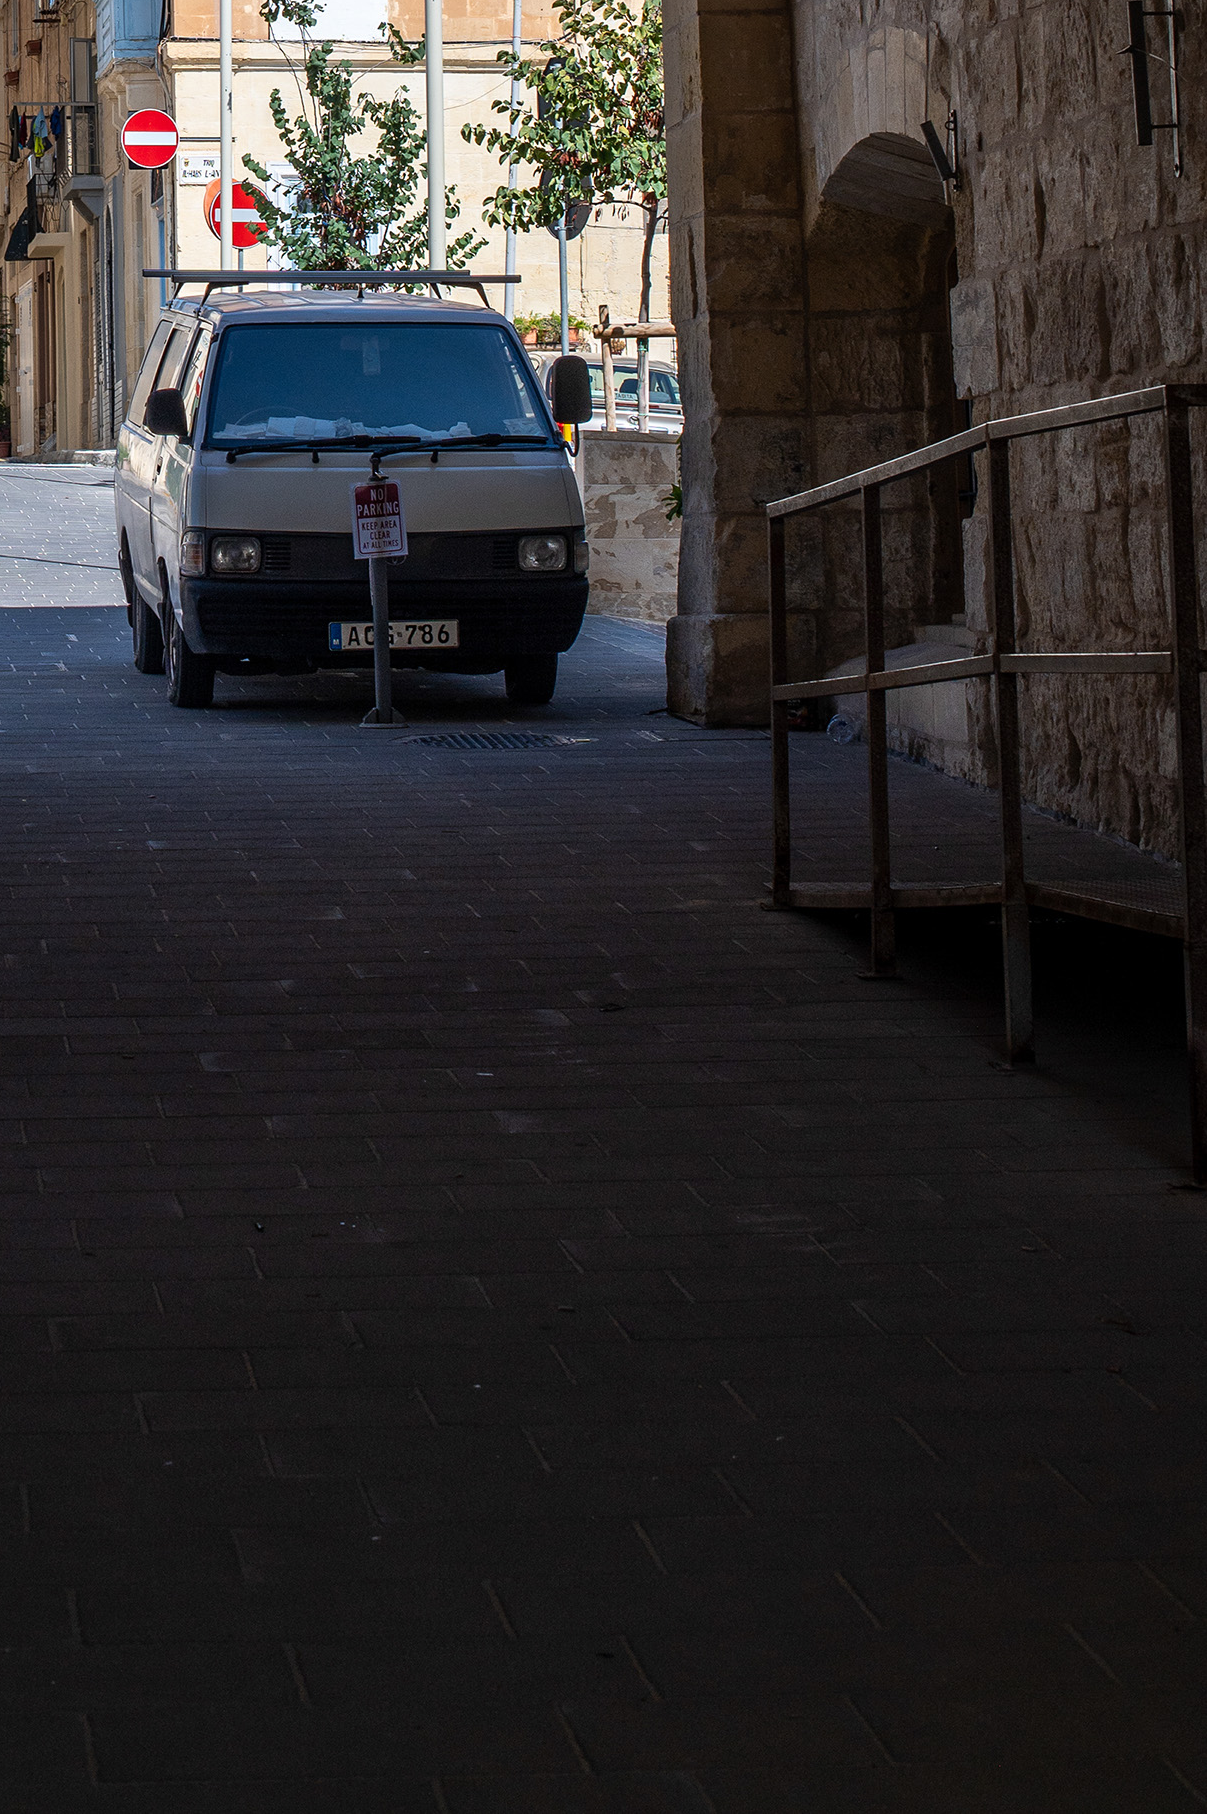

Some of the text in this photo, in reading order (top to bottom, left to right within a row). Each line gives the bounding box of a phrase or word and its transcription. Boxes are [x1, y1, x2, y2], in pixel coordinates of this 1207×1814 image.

[370, 488, 384, 501] NO
[357, 501, 399, 516] PARKING
[362, 520, 397, 530] KEEP AREA
[370, 531, 390, 540] CLEAR
